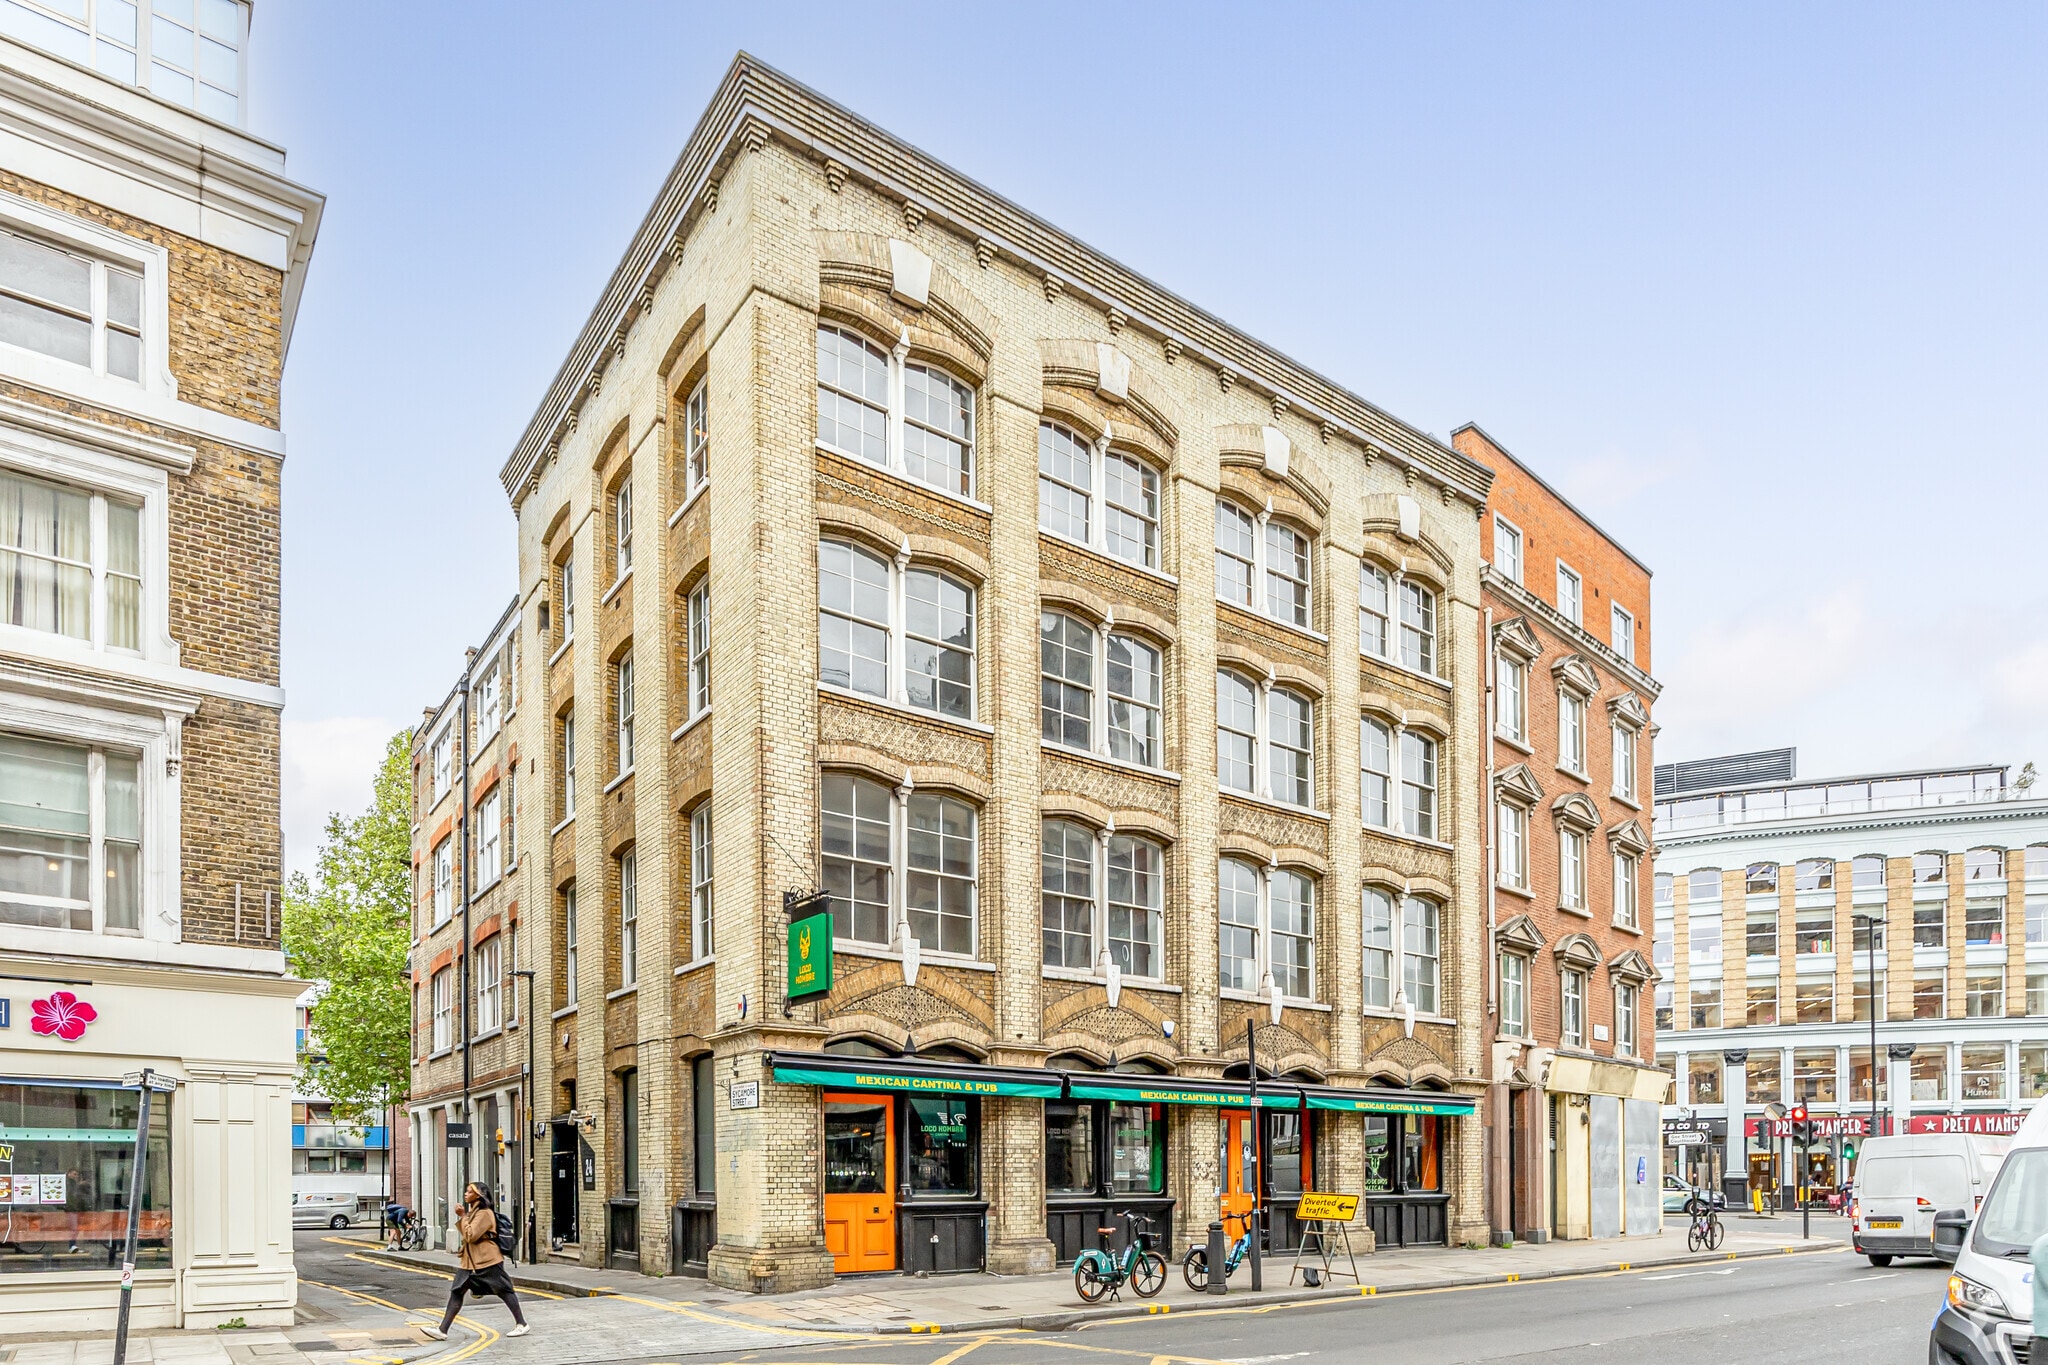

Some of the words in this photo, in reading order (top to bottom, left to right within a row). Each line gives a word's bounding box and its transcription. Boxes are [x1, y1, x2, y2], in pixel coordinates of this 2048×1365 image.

[799, 964, 811, 974] LOCO
[795, 972, 815, 984] HOMBRE
[855, 1075, 909, 1087] MEXICAN
[912, 1079, 962, 1090] CANTINA
[964, 1082, 973, 1091] &
[975, 1083, 998, 1093] PUB
[732, 1087, 756, 1098] SYCAMORE
[1140, 1091, 1180, 1100] MEXICAN
[1181, 1093, 1218, 1103] CANTINA
[1227, 1096, 1245, 1104] PUB
[732, 1097, 747, 1107] STREET
[1355, 1102, 1385, 1110] MEXICAN
[1385, 1104, 1415, 1112] CANTINA
[1421, 1105, 1434, 1113] PUB
[1676, 1122, 1691, 1130] CO
[1696, 1122, 1710, 1130] TD
[1942, 1117, 1971, 1133] PRET
[1973, 1117, 1983, 1133] A
[1985, 1115, 2026, 1132] MANGE
[1304, 1197, 1337, 1207] Diverted
[1305, 1206, 1330, 1216] traffic
